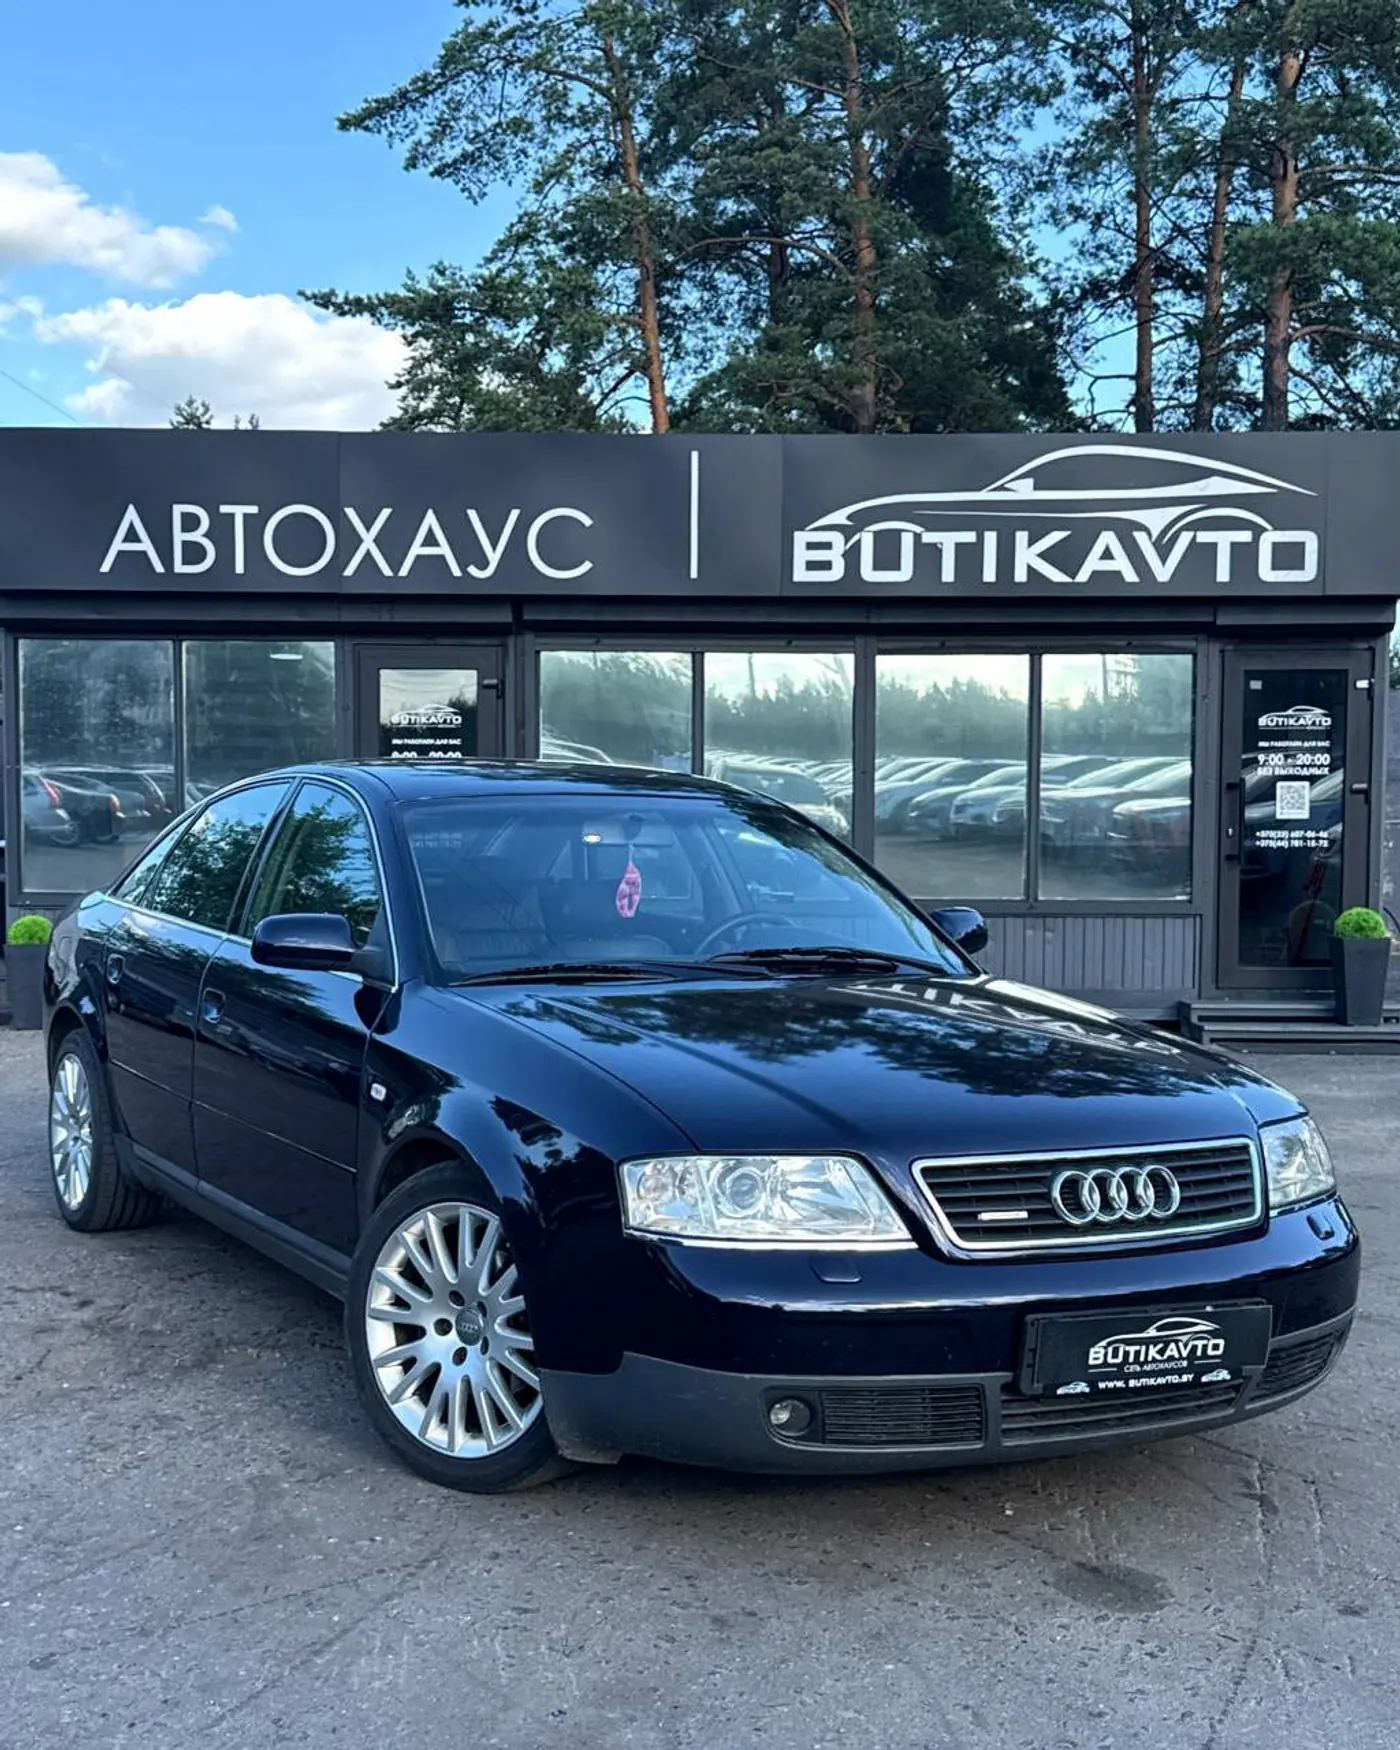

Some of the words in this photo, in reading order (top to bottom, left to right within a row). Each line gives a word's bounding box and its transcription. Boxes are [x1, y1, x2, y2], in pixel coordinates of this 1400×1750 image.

[100, 504, 594, 579] АВТОХАУС
[793, 531, 1318, 583] BUTIKAVTO
[1257, 753, 1284, 765] 9:00
[1296, 753, 1331, 765] 20:00
[1088, 1338, 1225, 1366] BUTIKAVTO
